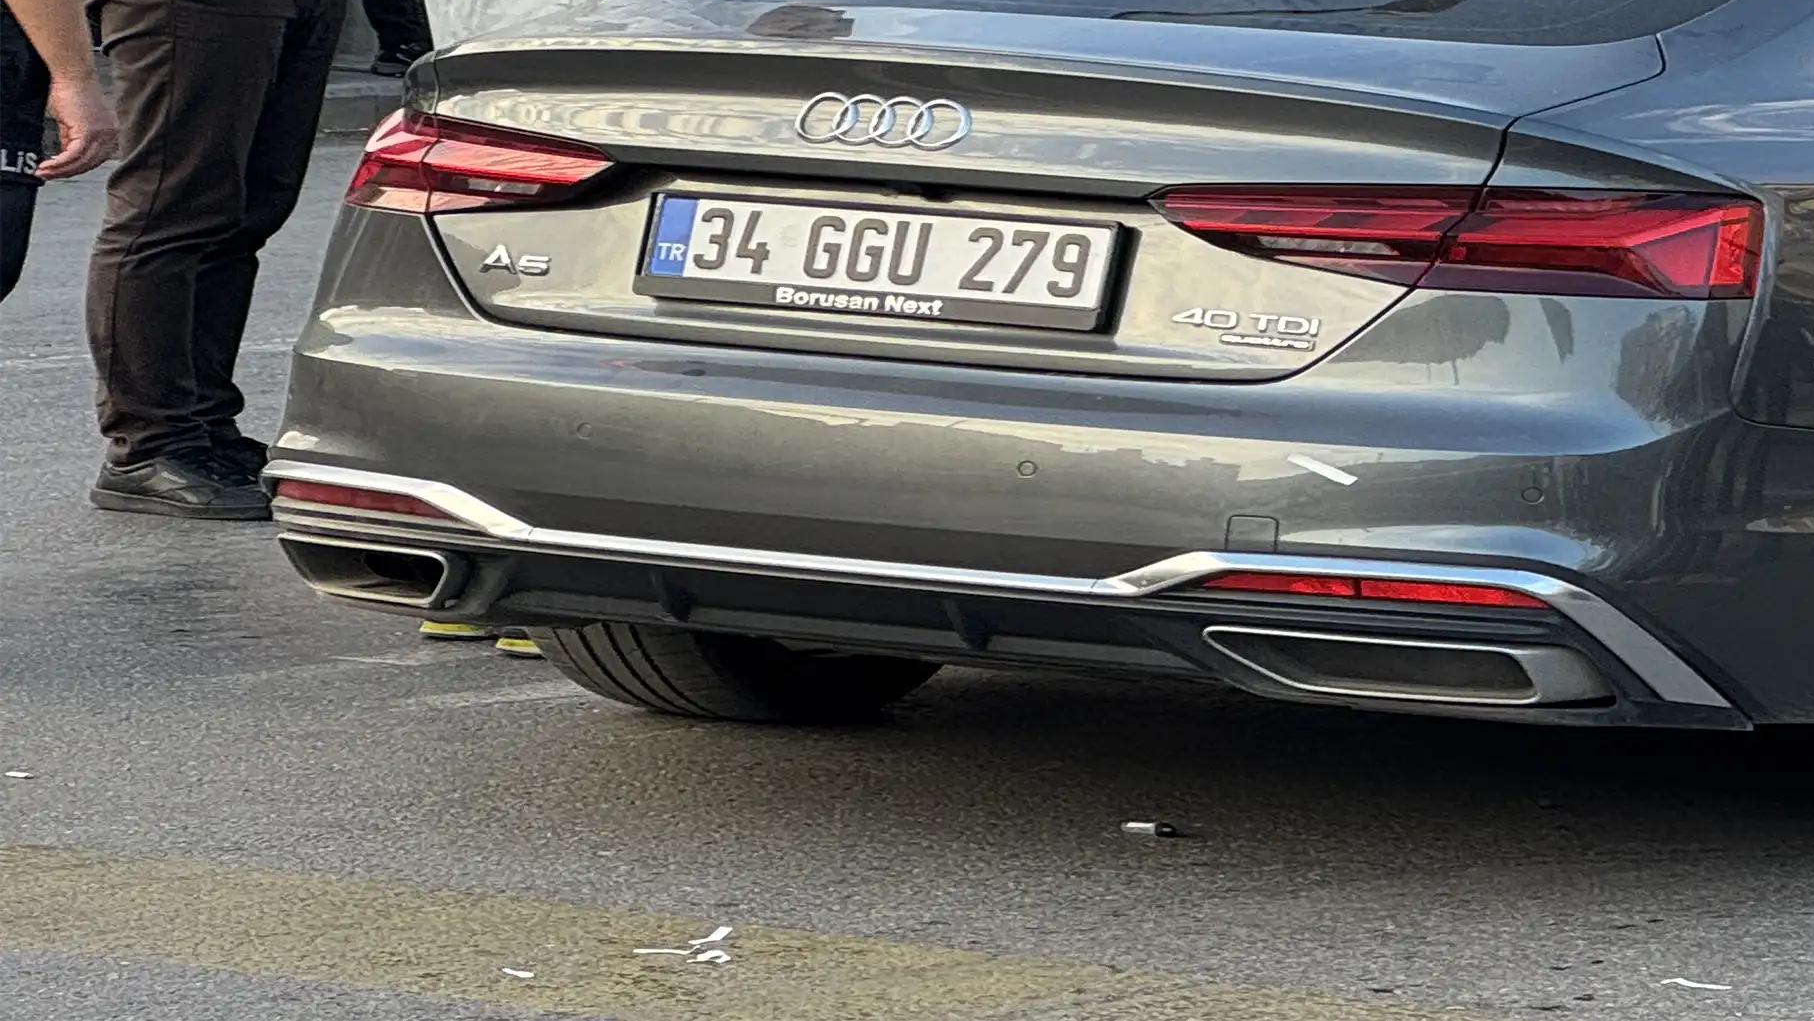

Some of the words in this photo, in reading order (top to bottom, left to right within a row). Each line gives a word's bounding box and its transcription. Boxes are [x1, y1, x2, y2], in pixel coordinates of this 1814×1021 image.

[479, 244, 551, 277] A5
[658, 242, 687, 261] TR
[693, 207, 770, 275] 34
[803, 215, 934, 286] GGU
[958, 226, 1092, 299] 279
[775, 286, 879, 311] Borusan
[884, 294, 944, 317] Next
[1171, 307, 1238, 329] 40
[1249, 313, 1321, 336] TDI
